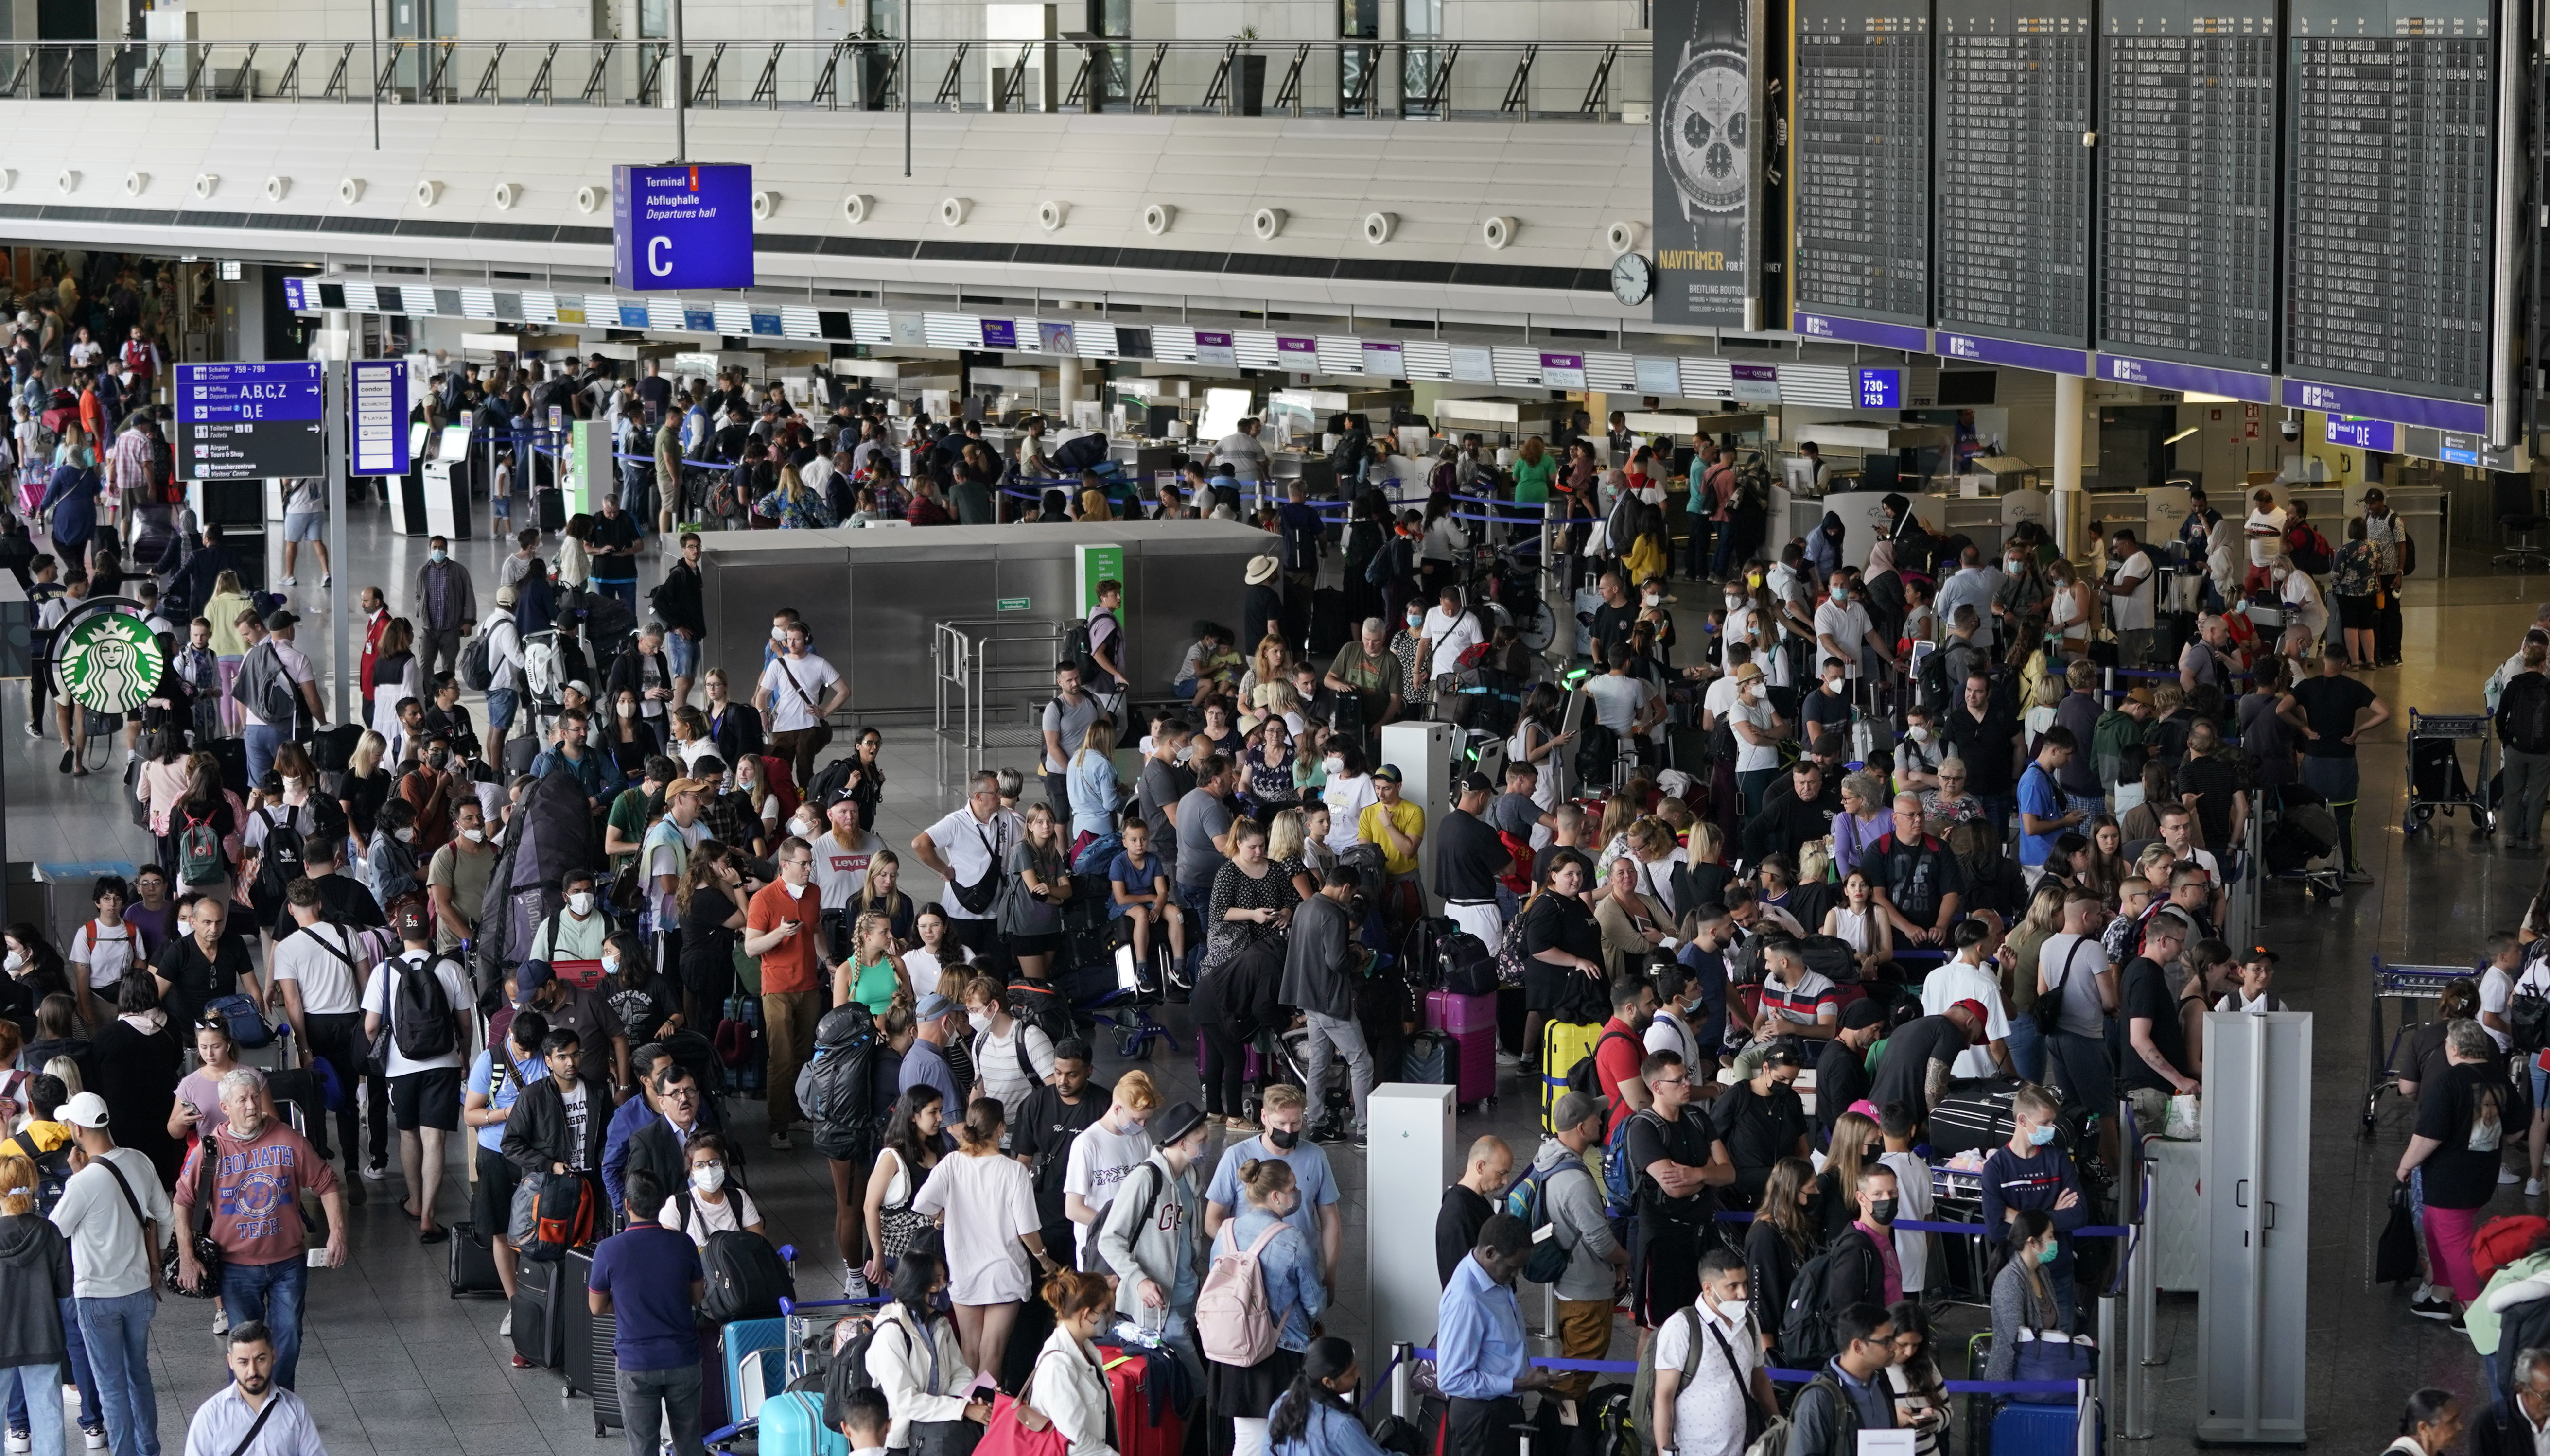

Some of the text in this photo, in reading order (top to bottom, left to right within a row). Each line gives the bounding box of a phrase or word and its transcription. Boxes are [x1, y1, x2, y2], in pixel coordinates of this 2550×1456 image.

[2332, 40, 2374, 50] WIEN-CANCELLED
[2332, 53, 2347, 63] BASEL
[2331, 67, 2355, 77] MONTREAL
[2331, 80, 2389, 91] LUXEMBURG-CANCELLED
[2331, 93, 2380, 104] NANTES-CANCELLED
[2331, 107, 2386, 118] SARAJEVO-CANCELLED
[2330, 120, 2469, 135] DOHA-HAMAD 734-742
[2330, 133, 2382, 145] HAMBURG-CANCELLED
[2330, 146, 2382, 158] HOUSTON-CANCELLED
[2330, 160, 2379, 172] BERGEN-CANCELLED
[646, 176, 696, 186] Terminal 1
[2329, 173, 2378, 185] LONDON-CANCELLED
[2329, 186, 2378, 199] AUSTIN-CANCELLED
[647, 195, 699, 206] Abflughalle
[2329, 200, 2378, 212] ZAGREB-CANCELLED
[647, 208, 716, 221] Departures hall
[2329, 213, 2368, 225] STUTTGART HBF
[2328, 226, 2356, 237] KOELN HBF
[616, 234, 621, 273] C
[2383, 244, 2389, 253] BH
[648, 236, 673, 277] C
[1659, 250, 1723, 271] NAVITIMER
[1726, 262, 1738, 271] FOR
[2328, 253, 2377, 266] NEAPEL-CANCELLED
[2328, 266, 2376, 279] DALLAS-CANCELLED
[1689, 285, 1718, 294] BREITLING
[2328, 280, 2373, 292] KAIRO-CANCELLED
[2328, 293, 2379, 306] TORONTO-CANCELLED
[2327, 306, 2465, 329] AMSTERDAM 801-804
[2327, 319, 2381, 333] MUENCHEN-CANCELLED
[2327, 333, 2378, 347] ATLANTA-CANCELLED
[2327, 346, 2384, 361] STOCKHOLM-CANCELLED
[2131, 362, 2141, 372] Abflug
[2327, 359, 2372, 373] SOFIA-CANCELLED
[2131, 372, 2147, 382] Departures
[240, 385, 286, 399] A,B,C,Z
[1864, 381, 1889, 392] 730-
[1864, 395, 1883, 405] 753
[2322, 389, 2333, 399] Abflug
[2322, 399, 2341, 410] Departures
[243, 405, 263, 419] D,E
[2337, 424, 2350, 432] Terminal
[2357, 426, 2369, 446] D,E
[608, 990, 652, 1006] VINTAGE
